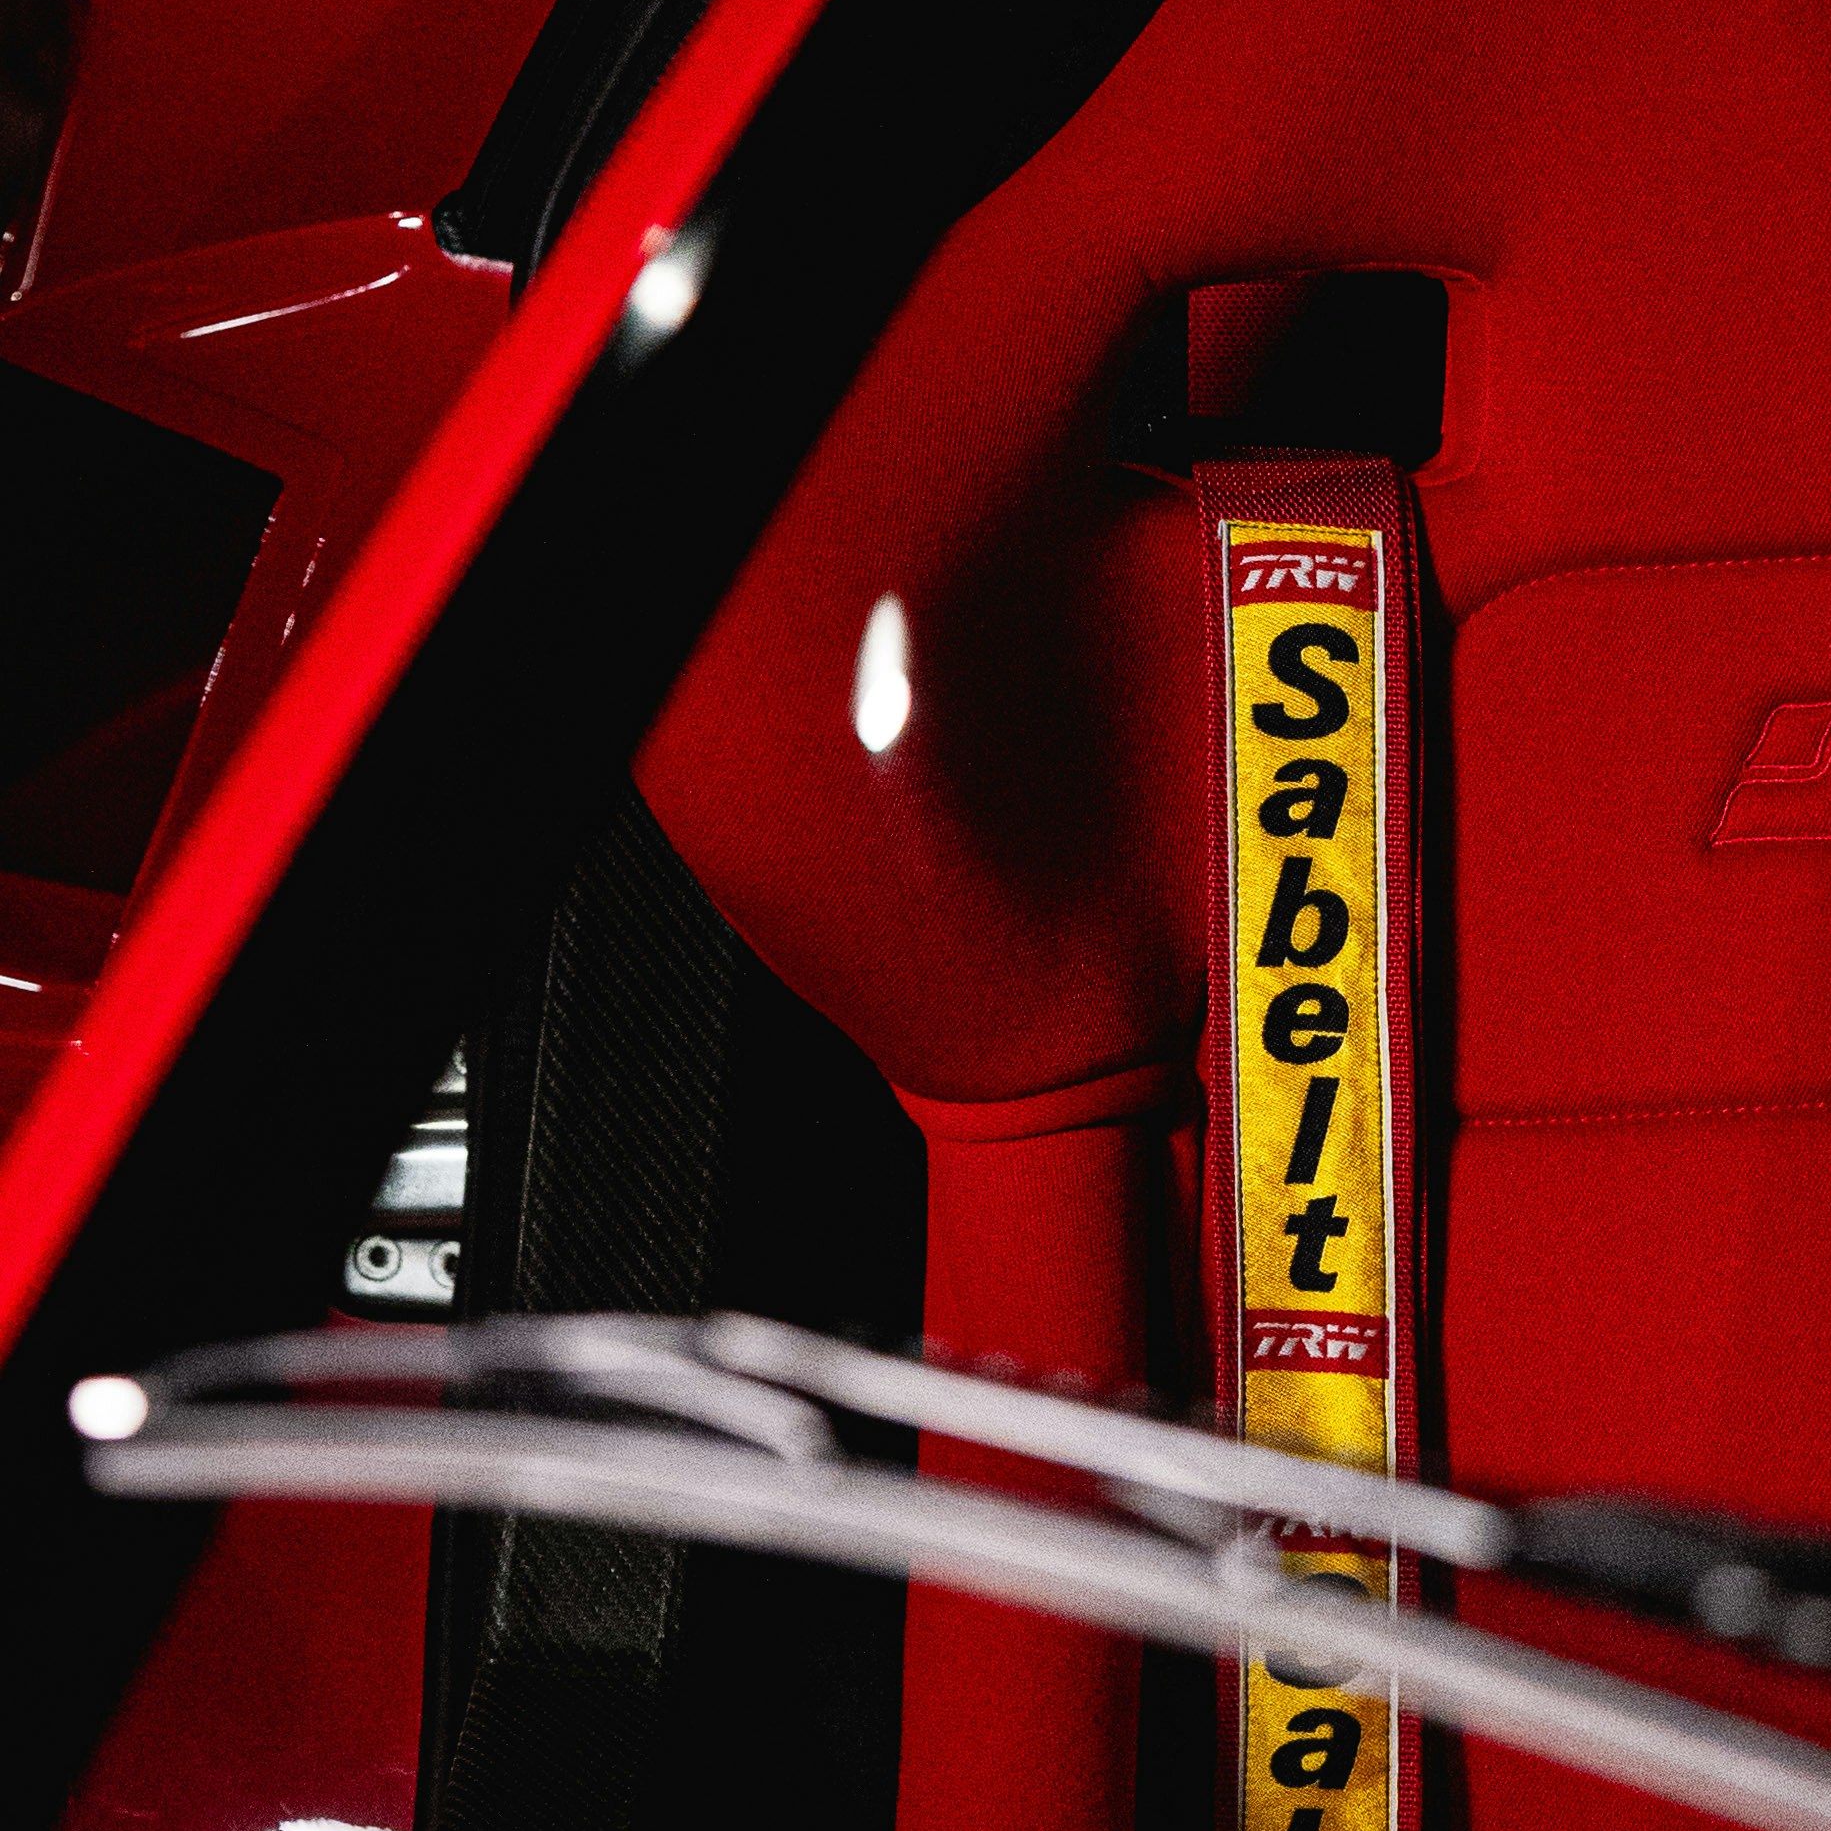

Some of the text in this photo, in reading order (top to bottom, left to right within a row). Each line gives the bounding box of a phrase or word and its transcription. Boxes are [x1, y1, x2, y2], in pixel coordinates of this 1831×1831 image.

[1239, 553, 1366, 593] TRW
[1252, 623, 1360, 1292] Sabelt
[1252, 1321, 1379, 1362] TRW
